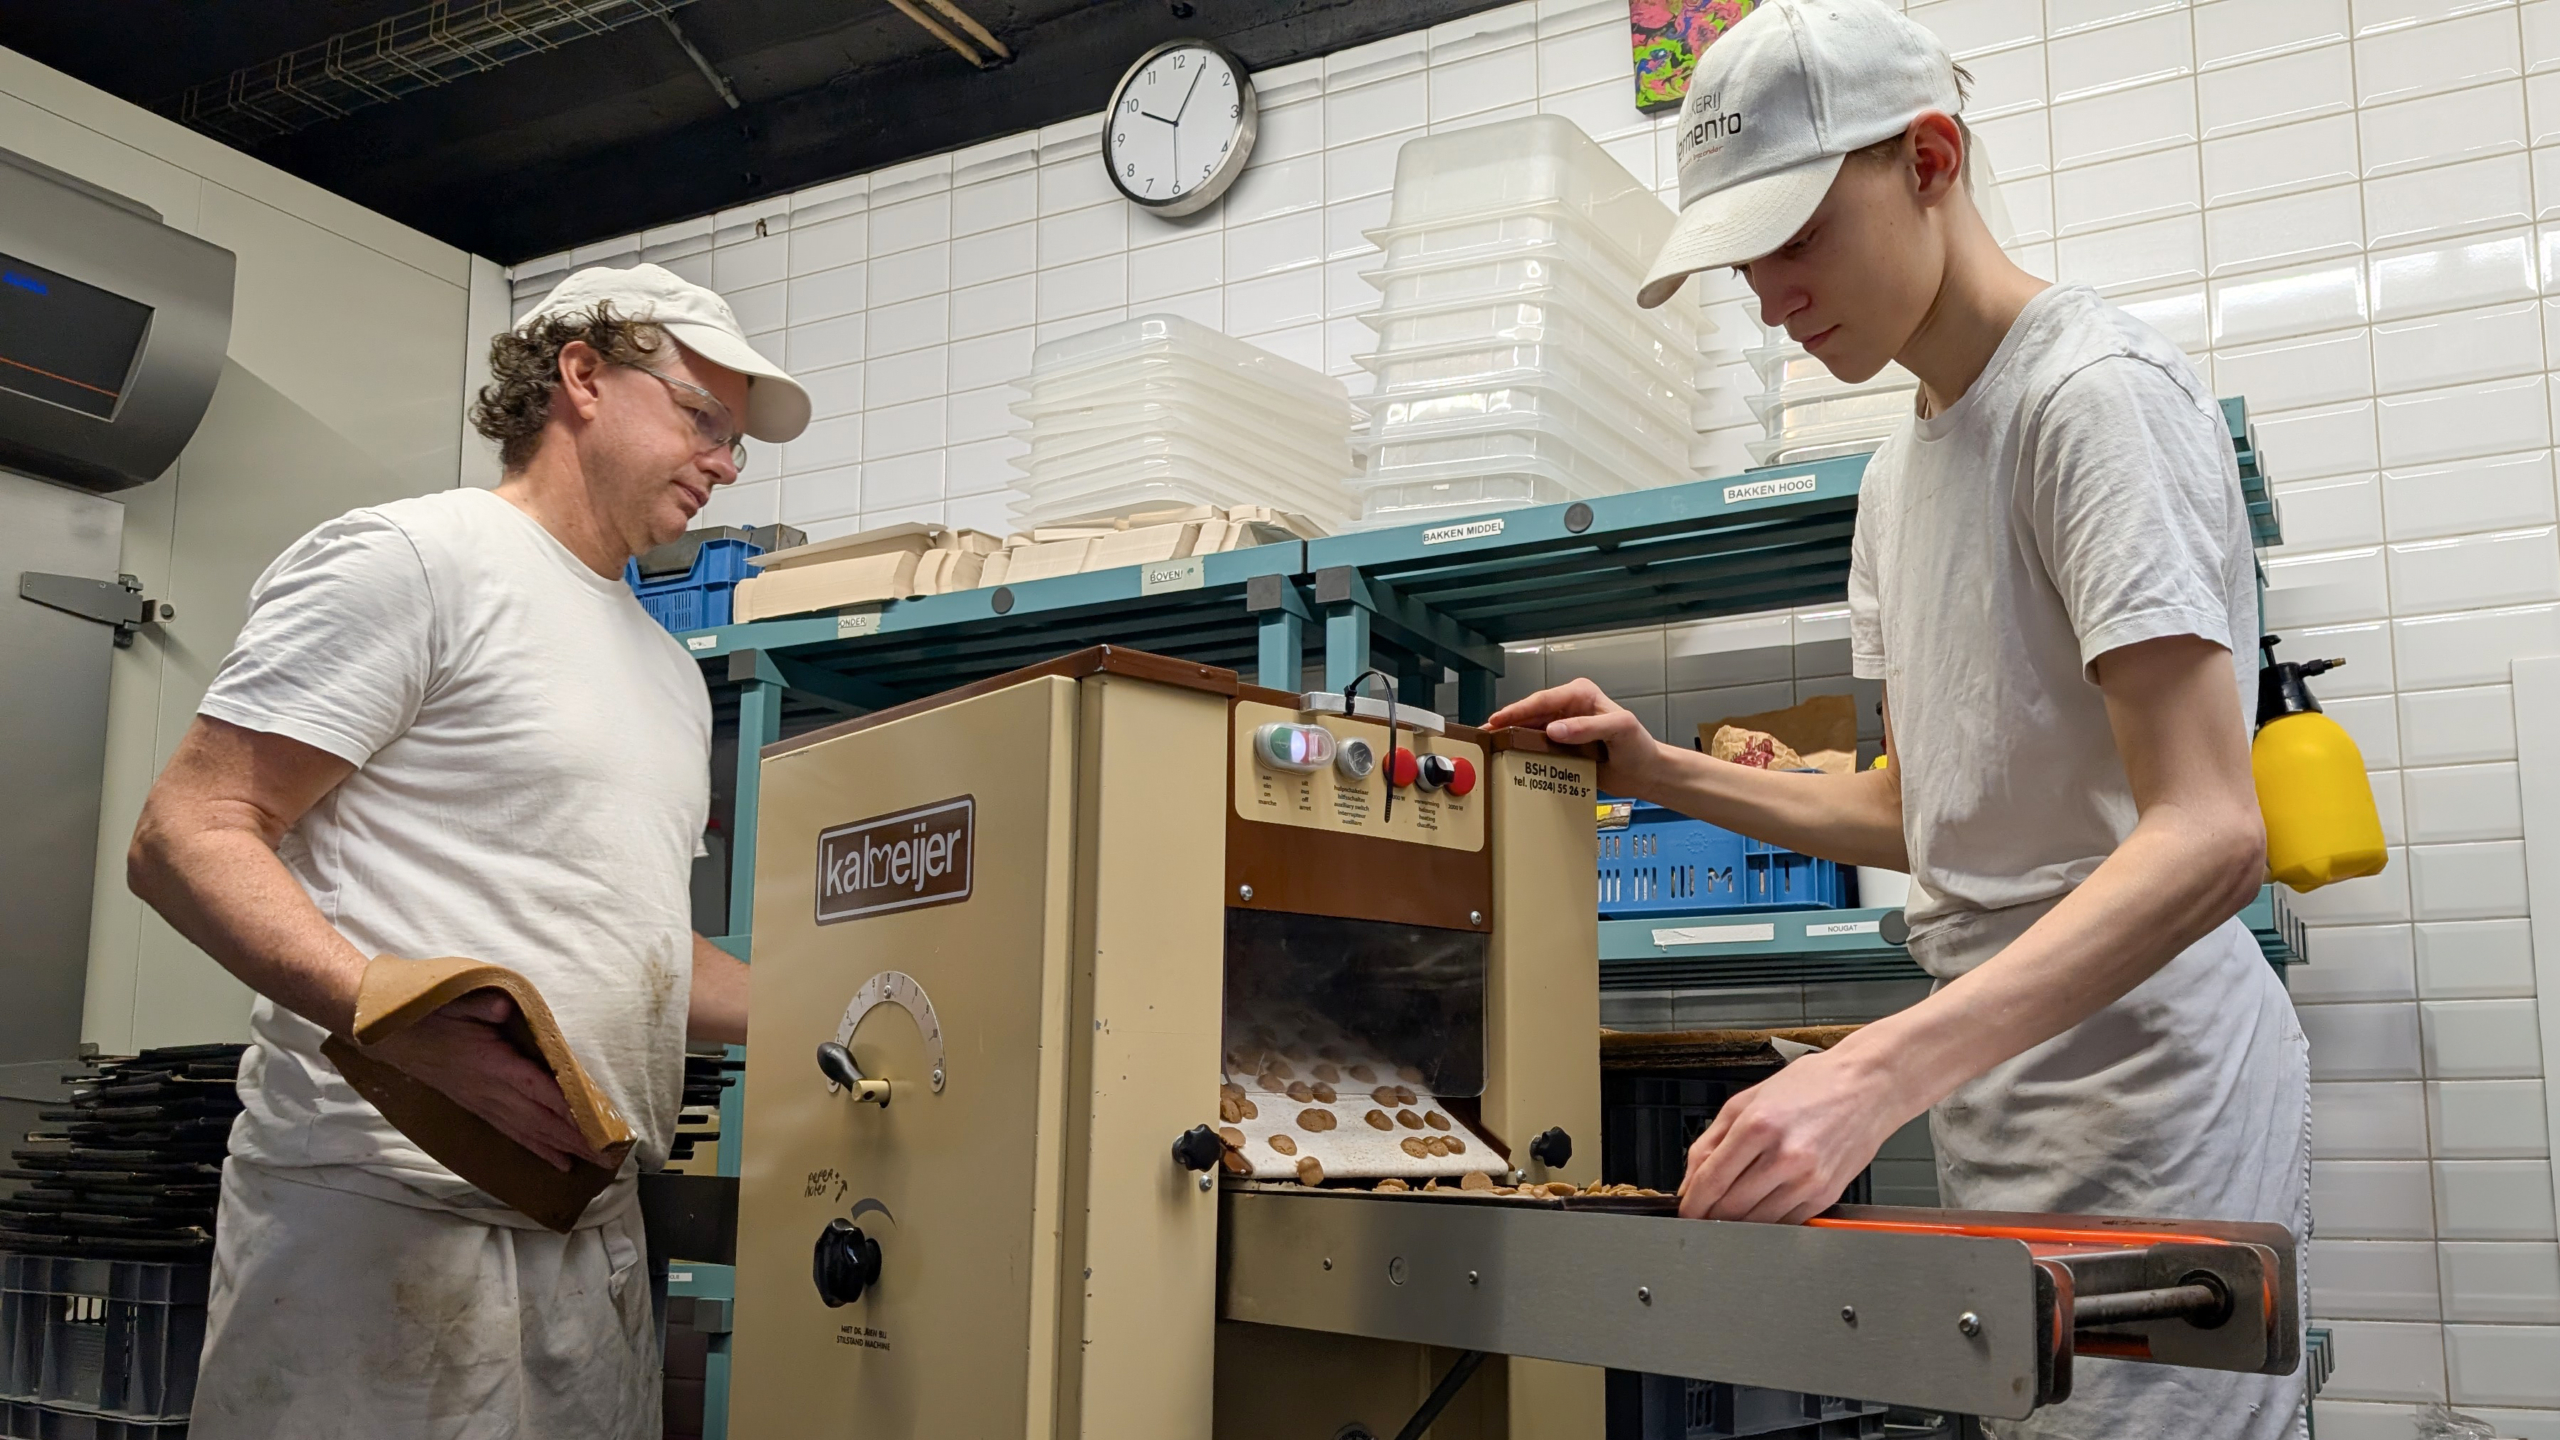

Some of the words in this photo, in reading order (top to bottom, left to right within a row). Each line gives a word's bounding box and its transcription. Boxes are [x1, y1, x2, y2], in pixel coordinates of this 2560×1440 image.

[1172, 54, 1186, 70] 12
[1202, 56, 1208, 70] 1
[1147, 70, 1156, 85] 11
[1222, 72, 1231, 86] 2
[1126, 98, 1140, 114] 10
[1230, 104, 1240, 118] 3
[1117, 133, 1126, 148] 9
[1677, 112, 1742, 163] ermento
[1220, 140, 1228, 152] 4
[1126, 163, 1135, 178] 8
[1202, 164, 1211, 180] 5
[1146, 178, 1154, 194] 7
[1172, 180, 1181, 194] 6
[1728, 484, 1775, 499] BAKKEN
[1779, 479, 1813, 492] HOOG
[1424, 528, 1463, 542] BAKKEN
[1466, 522, 1503, 535] MIDDEL
[1150, 571, 1180, 582] BOVEN
[840, 617, 866, 627] ONDER
[1525, 761, 1547, 777] BSH
[1550, 766, 1580, 783] Dalen
[1514, 776, 1527, 787] tel.
[1529, 778, 1555, 794] (0524)
[1558, 784, 1567, 794] 55
[1569, 786, 1579, 796] 26
[1828, 924, 1858, 932] NOUGAT
[864, 1340, 890, 1351] MACHINE
